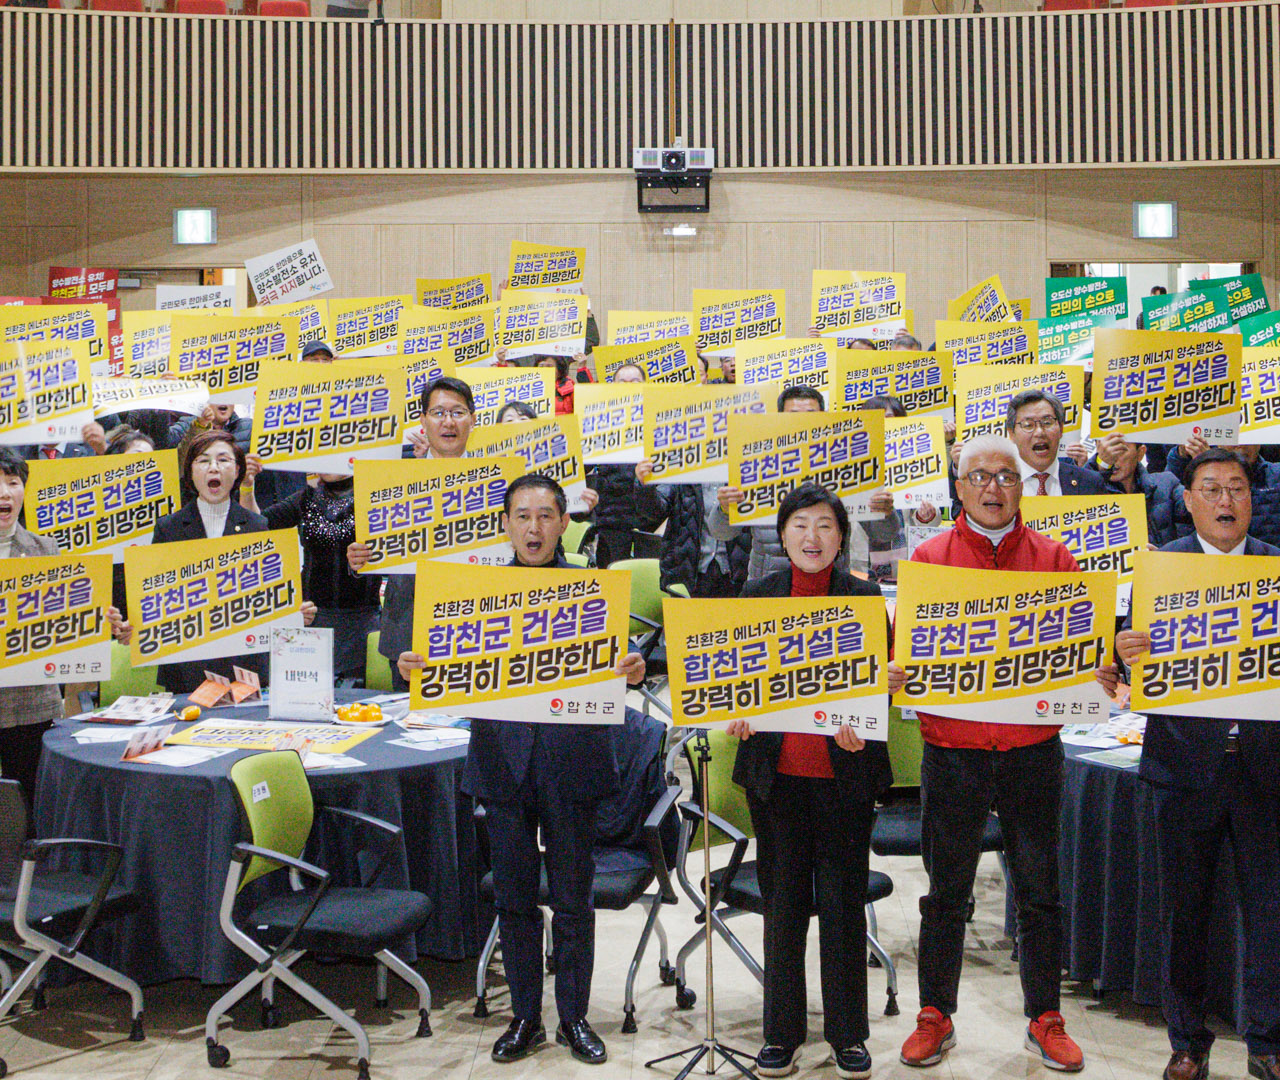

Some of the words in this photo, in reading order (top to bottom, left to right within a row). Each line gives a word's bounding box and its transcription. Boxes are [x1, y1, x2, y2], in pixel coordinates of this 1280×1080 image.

[257, 264, 298, 294] 양수발전소
[300, 252, 318, 269] 유치
[511, 274, 539, 287] 강력히
[542, 269, 580, 284] 희망한다
[514, 261, 544, 273] 합천군
[548, 257, 577, 270] 건설을
[819, 293, 854, 312] 합천군
[859, 285, 896, 305] 건설을
[816, 311, 850, 330] 강력히
[854, 301, 901, 322] 희망한다
[22, 562, 86, 588] 양수발전소
[17, 577, 92, 620] 건설을
[433, 598, 474, 618] 친환경
[480, 592, 522, 613] 에너지
[528, 578, 600, 605] 양수발전소
[916, 601, 959, 619] 친환경
[965, 596, 1009, 616] 에너지
[1015, 581, 1087, 608] 양수발전소
[5, 607, 102, 656] 희망한다
[429, 616, 510, 658] 합천군
[522, 598, 606, 645] 건설을
[911, 619, 996, 657] 합천군
[1009, 600, 1093, 648] 건설을
[60, 662, 101, 674] 합천군
[286, 670, 318, 683] 내빈석
[421, 657, 499, 698] 강력히
[507, 636, 618, 687] 희망한다
[904, 660, 984, 695] 강력히
[992, 637, 1104, 688] 희망한다
[568, 701, 614, 714] 합천군
[1054, 702, 1100, 715] 합천군
